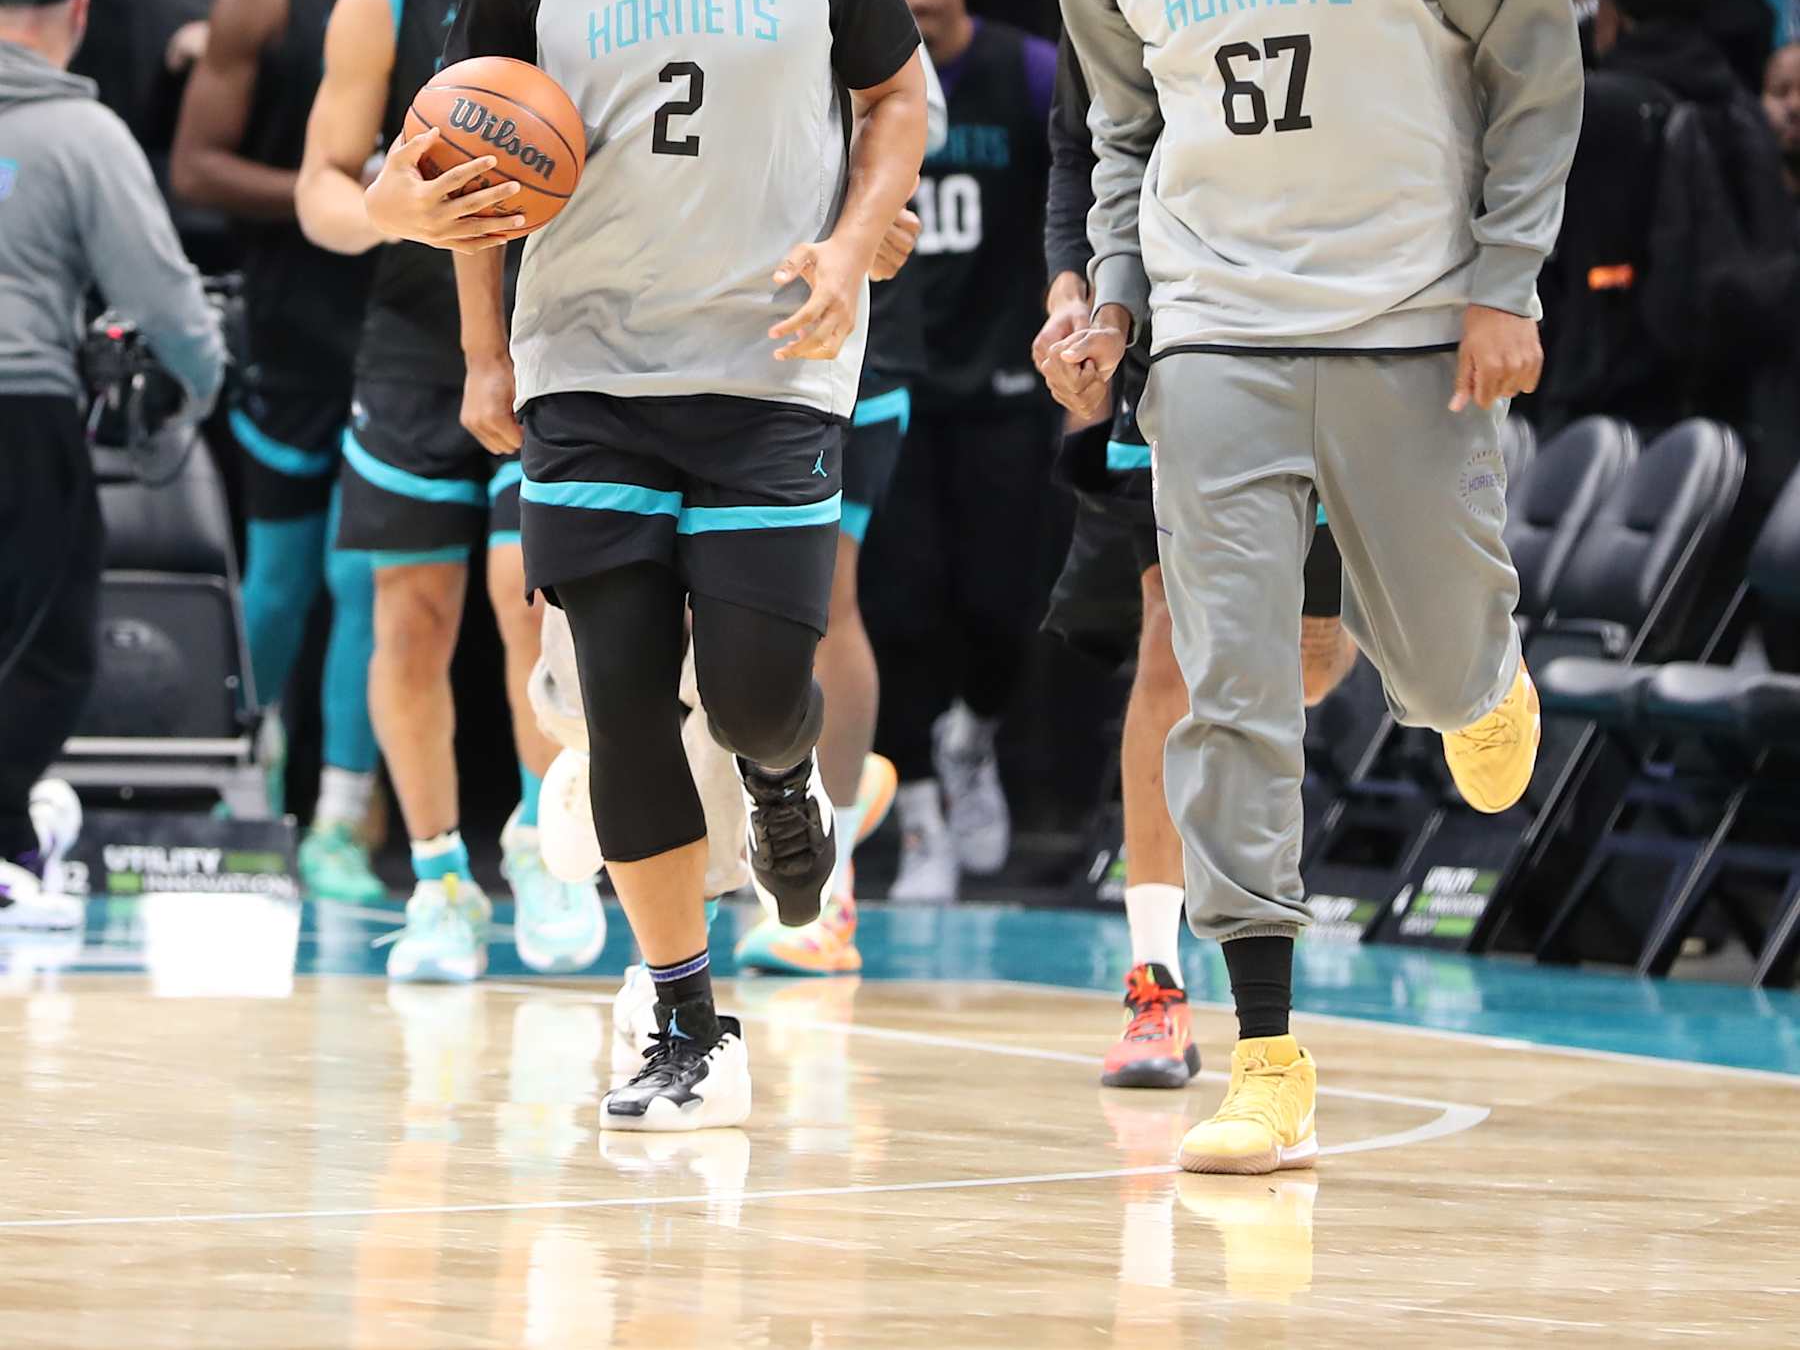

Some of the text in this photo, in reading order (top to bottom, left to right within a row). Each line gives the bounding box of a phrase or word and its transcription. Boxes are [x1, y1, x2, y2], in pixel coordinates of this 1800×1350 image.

[651, 61, 704, 157] 2
[1214, 34, 1312, 135] 67
[449, 97, 556, 181] Wilson
[914, 174, 982, 254] 10
